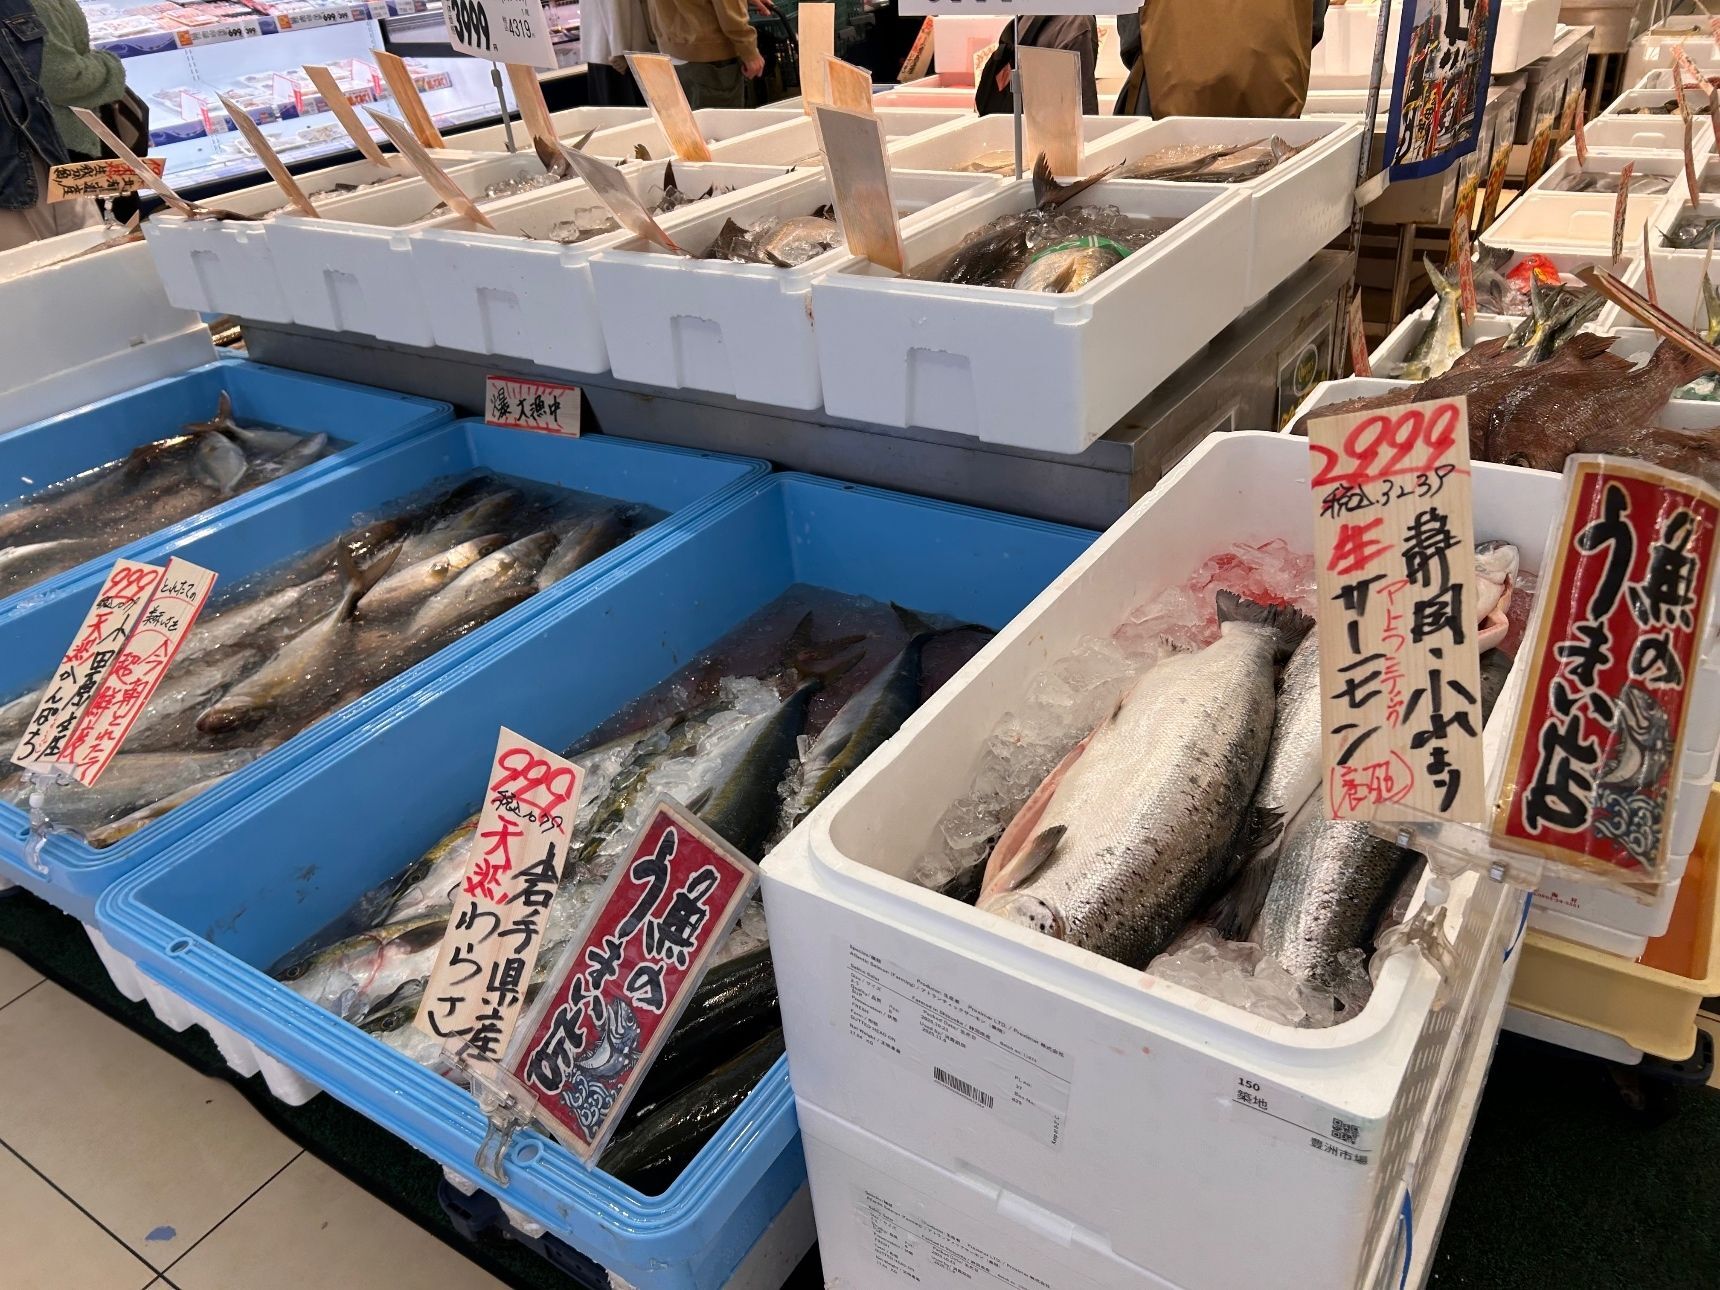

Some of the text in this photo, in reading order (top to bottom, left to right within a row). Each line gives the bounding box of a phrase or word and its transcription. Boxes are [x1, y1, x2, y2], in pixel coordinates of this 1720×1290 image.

[508, 18, 532, 38] 4319
[1311, 403, 1471, 489] 2999
[490, 748, 576, 822] 999
[1238, 1077, 1260, 1091] 150
[1237, 1089, 1268, 1110] 築地
